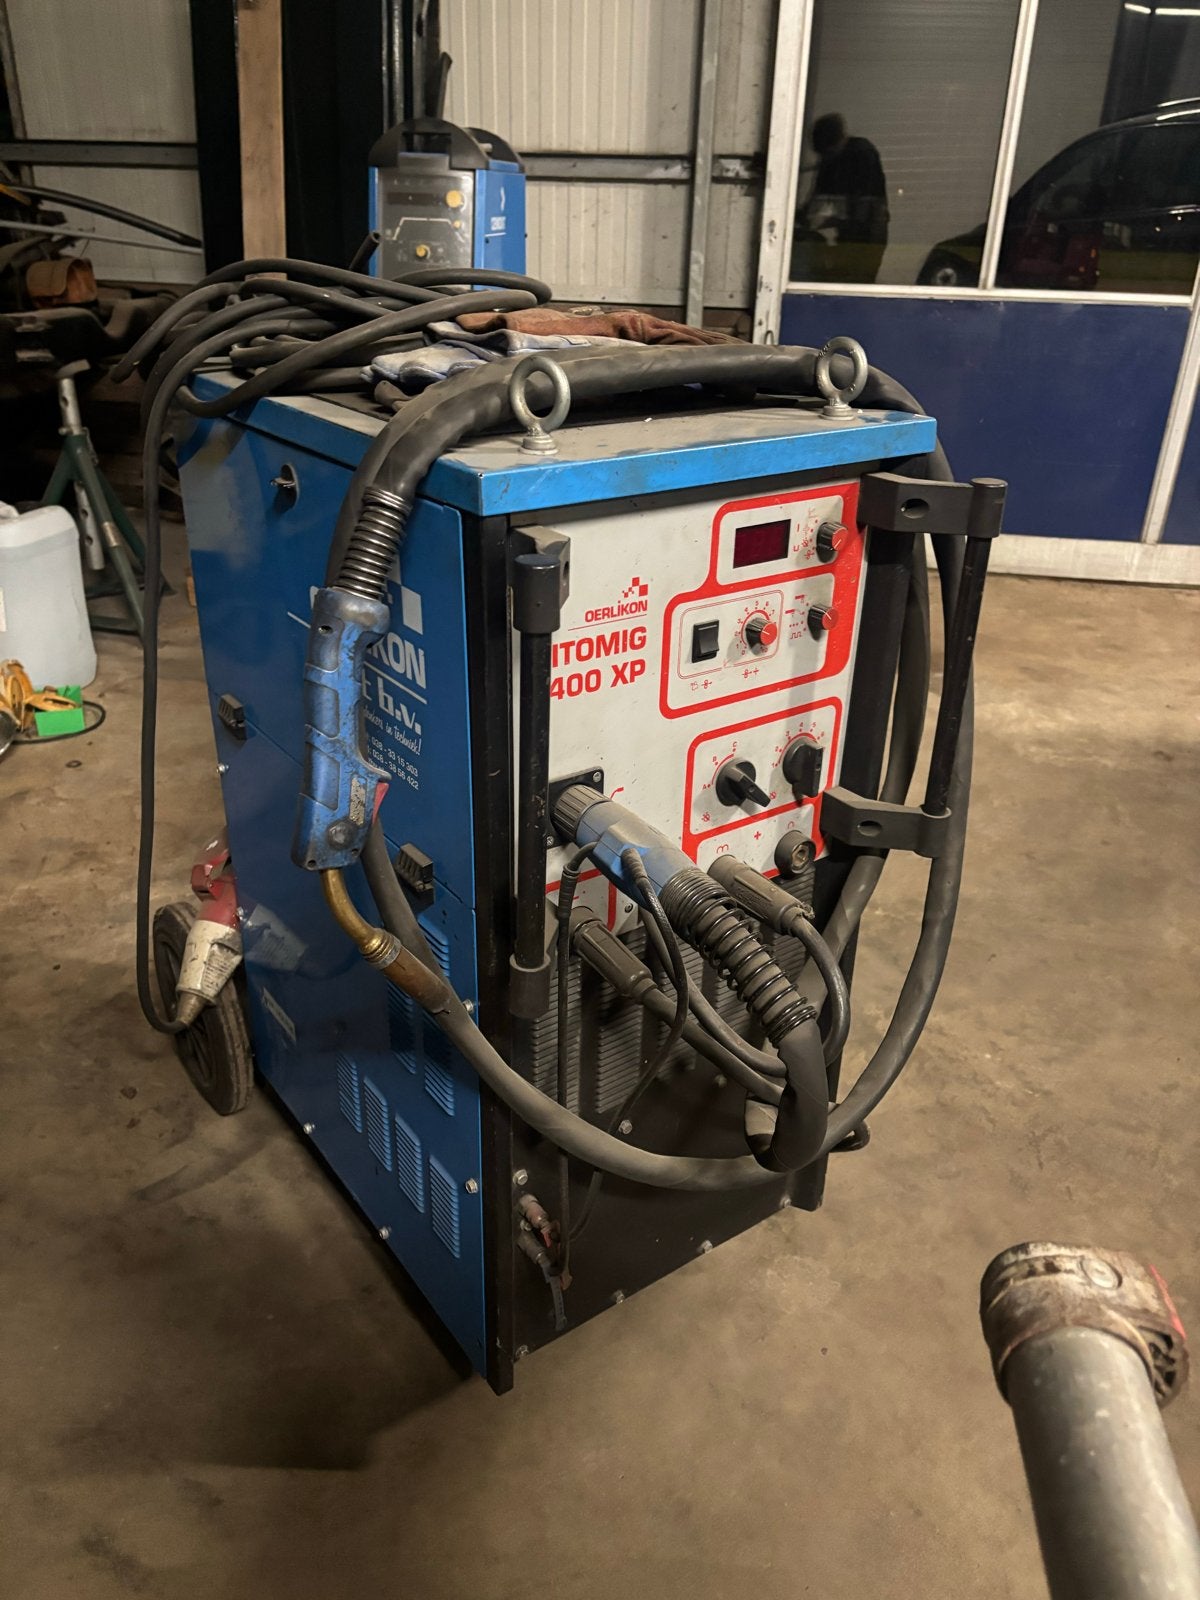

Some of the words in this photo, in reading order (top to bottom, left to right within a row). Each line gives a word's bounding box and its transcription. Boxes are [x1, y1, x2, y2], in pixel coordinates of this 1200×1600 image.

[367, 631, 427, 690] KON
[551, 626, 648, 669] ITOMIG
[550, 668, 602, 701] 400
[609, 658, 647, 689] XP
